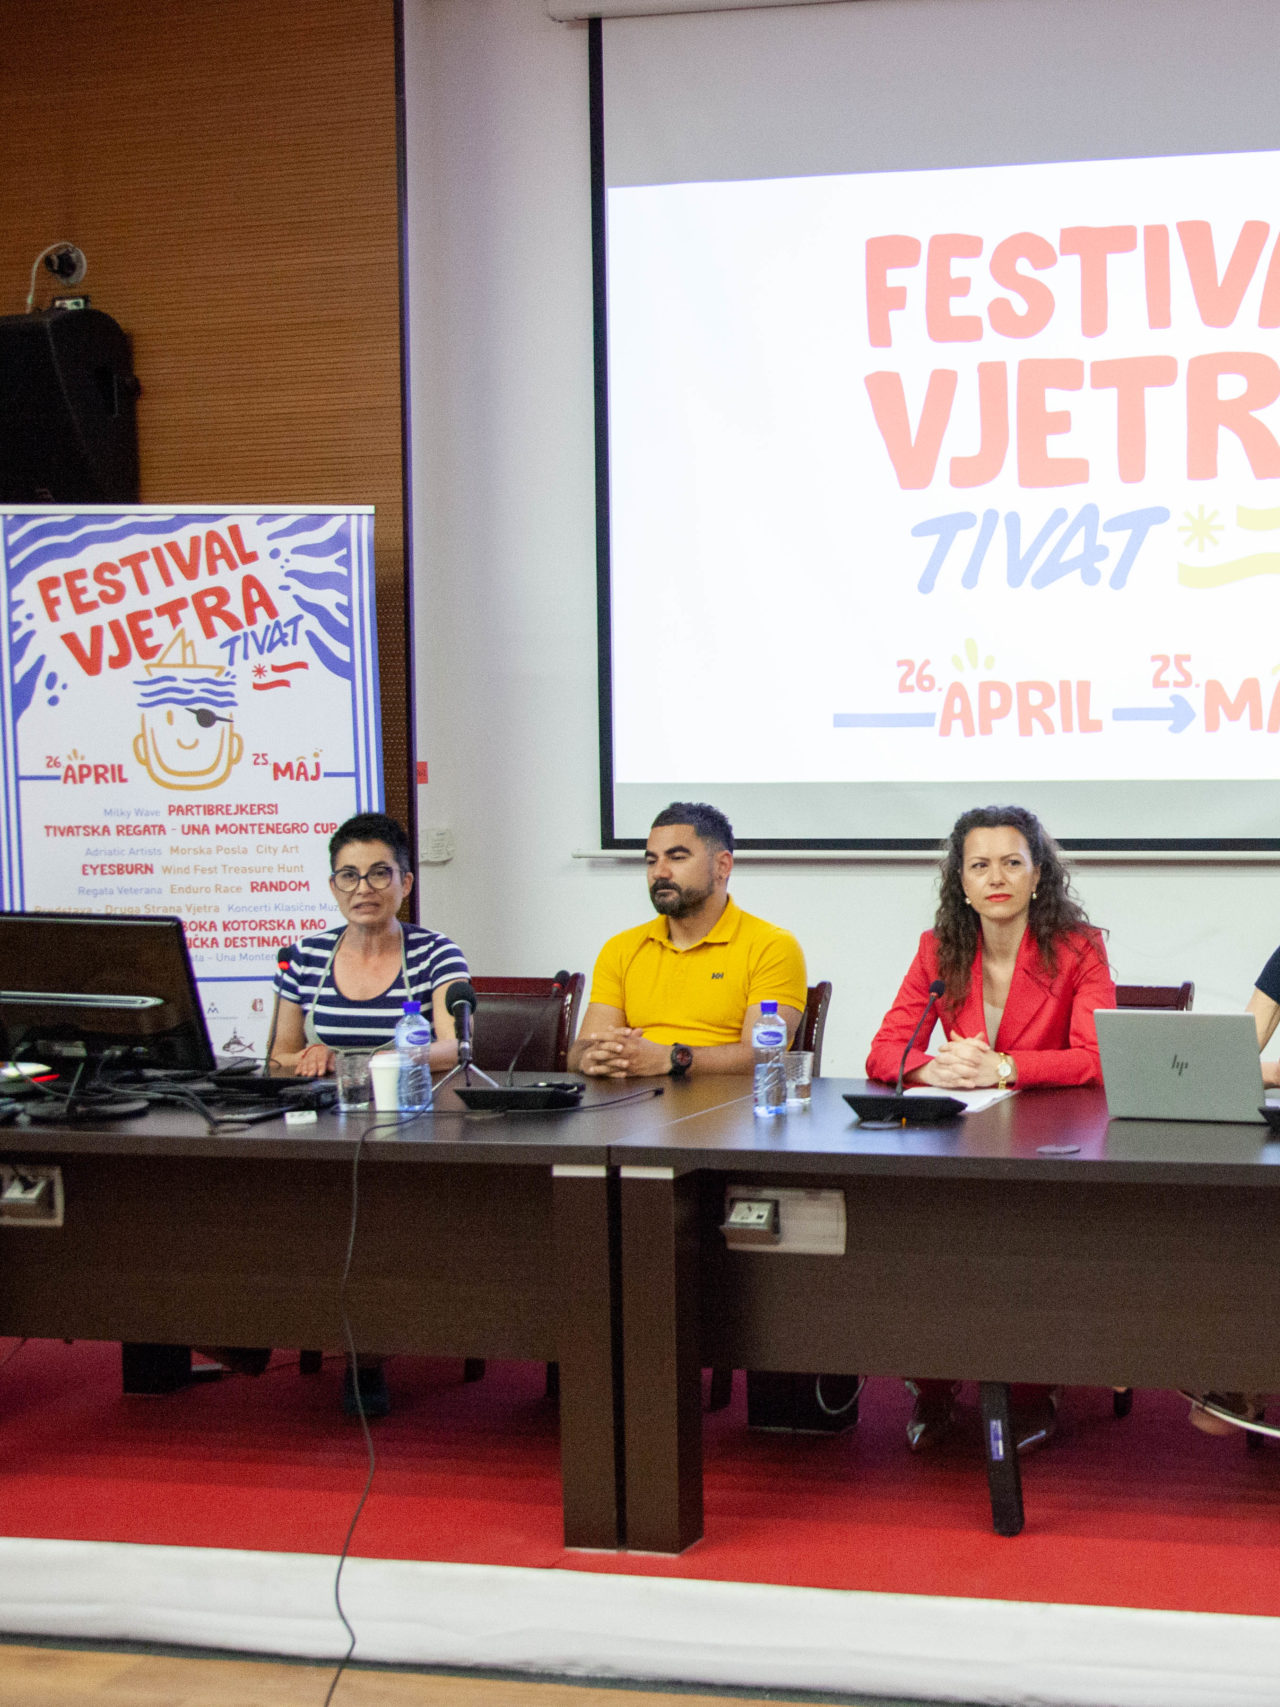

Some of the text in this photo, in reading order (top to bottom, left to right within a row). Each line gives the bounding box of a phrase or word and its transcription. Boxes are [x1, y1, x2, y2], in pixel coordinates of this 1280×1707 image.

[911, 503, 1171, 594] TIVAT
[37, 523, 259, 622] FESTIVAL
[60, 574, 279, 677] VJETRA
[219, 615, 304, 666] TIVAT
[1151, 654, 1200, 688] 25.
[897, 659, 1103, 737] 26. APRIL
[62, 764, 128, 784] APRIL
[272, 762, 321, 782] MAJ
[104, 803, 279, 818] Milky Wave PARTIBREJKERSI
[44, 825, 111, 837] TIVATSKA
[116, 824, 167, 836] REGATA
[181, 823, 210, 835] UNA
[215, 823, 309, 834] MONTENEGRO
[314, 822, 338, 834] CUP
[85, 848, 125, 856] Adriatic
[129, 848, 162, 856] Artists
[170, 845, 212, 855] Morska
[256, 844, 278, 856] City
[282, 844, 299, 854] Art
[82, 864, 304, 876] EYESBURN Wind Fest Treasure Hunt
[78, 880, 310, 897] Regata Veterana Enduro Race RANDOM
[144, 904, 182, 913] Strana
[185, 904, 220, 915] Vjetra
[228, 904, 271, 912] Koncerti
[319, 902, 339, 911] Muz
[222, 919, 295, 932] KOTORSKA
[301, 918, 327, 930] KAO
[224, 935, 304, 948] DESTINACIJ
[216, 953, 236, 962] Una
[239, 952, 278, 961] Monten
[1171, 1054, 1189, 1076] hp
